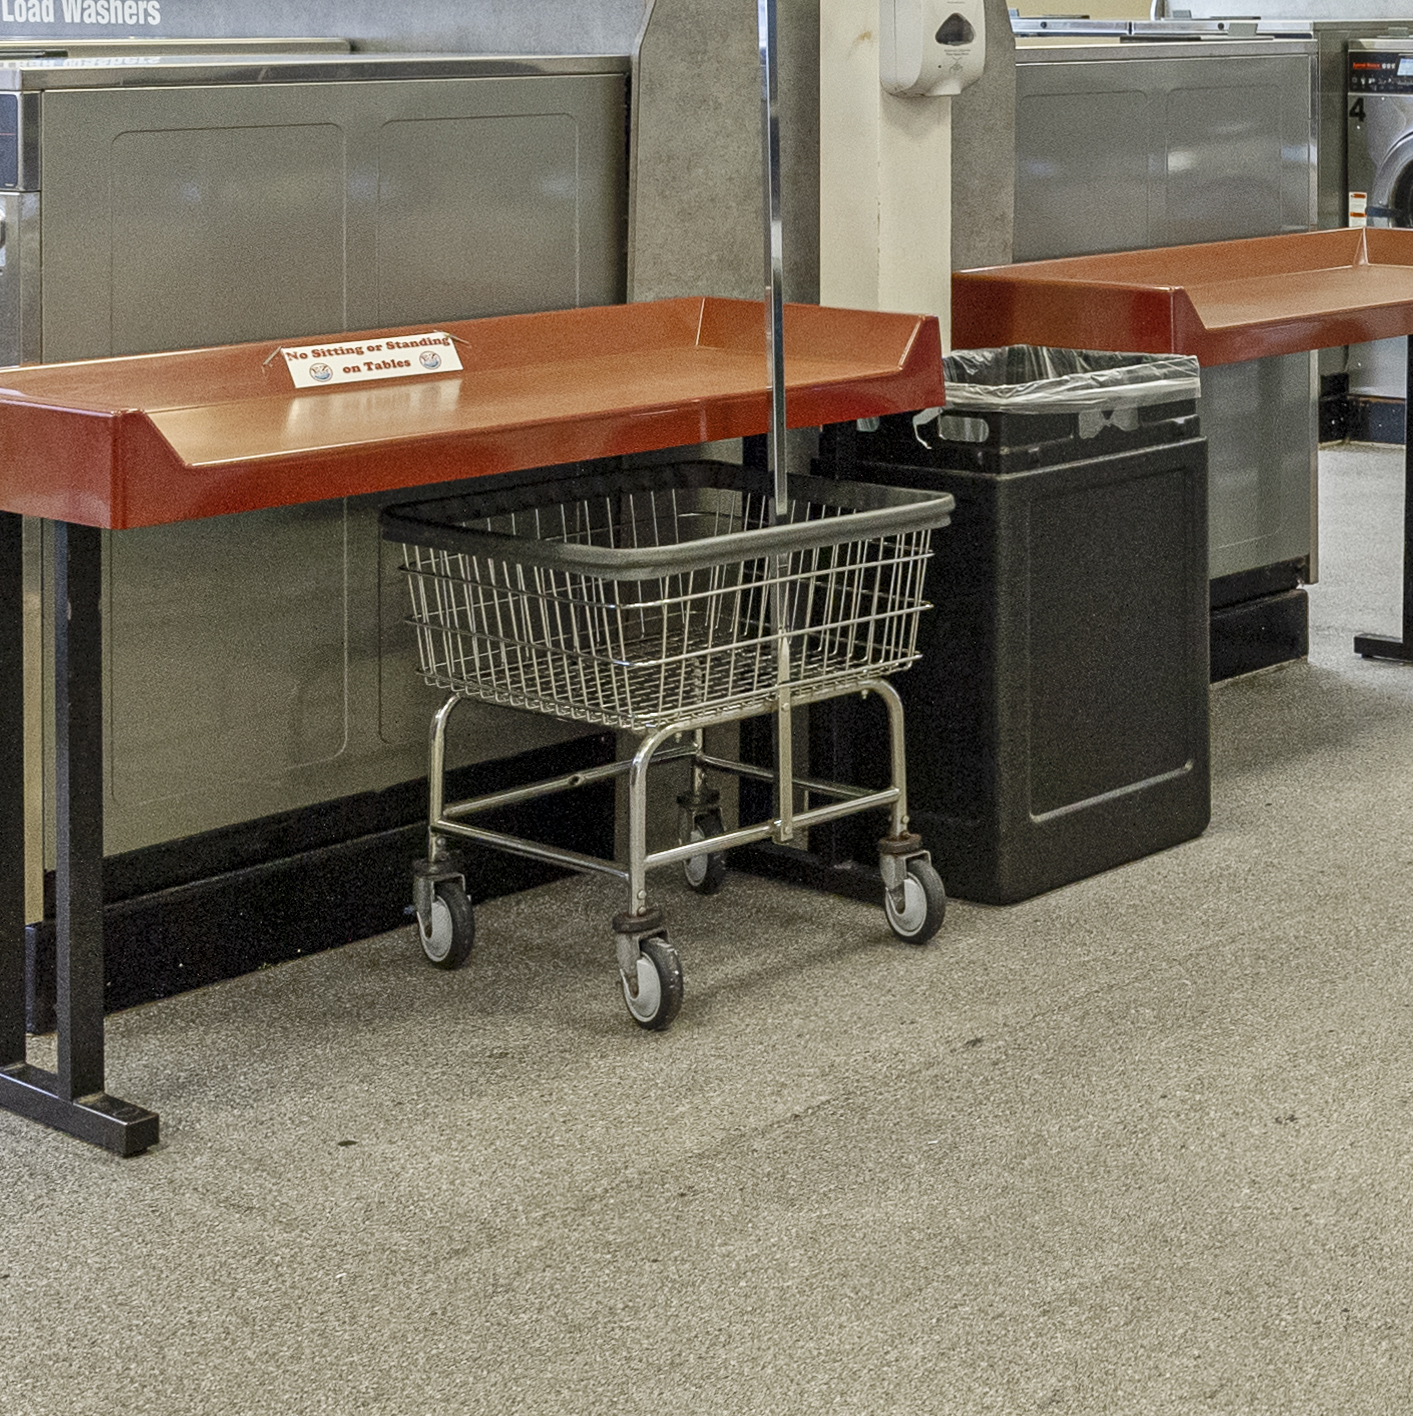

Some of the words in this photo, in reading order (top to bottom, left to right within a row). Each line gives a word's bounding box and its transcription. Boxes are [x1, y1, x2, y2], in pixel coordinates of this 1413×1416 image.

[1349, 97, 1366, 123] 4
[286, 350, 309, 362] No
[312, 345, 364, 358] Sitting
[366, 341, 383, 352] or
[385, 336, 451, 351] Standing
[343, 364, 361, 374] on
[364, 358, 411, 372] Tables
